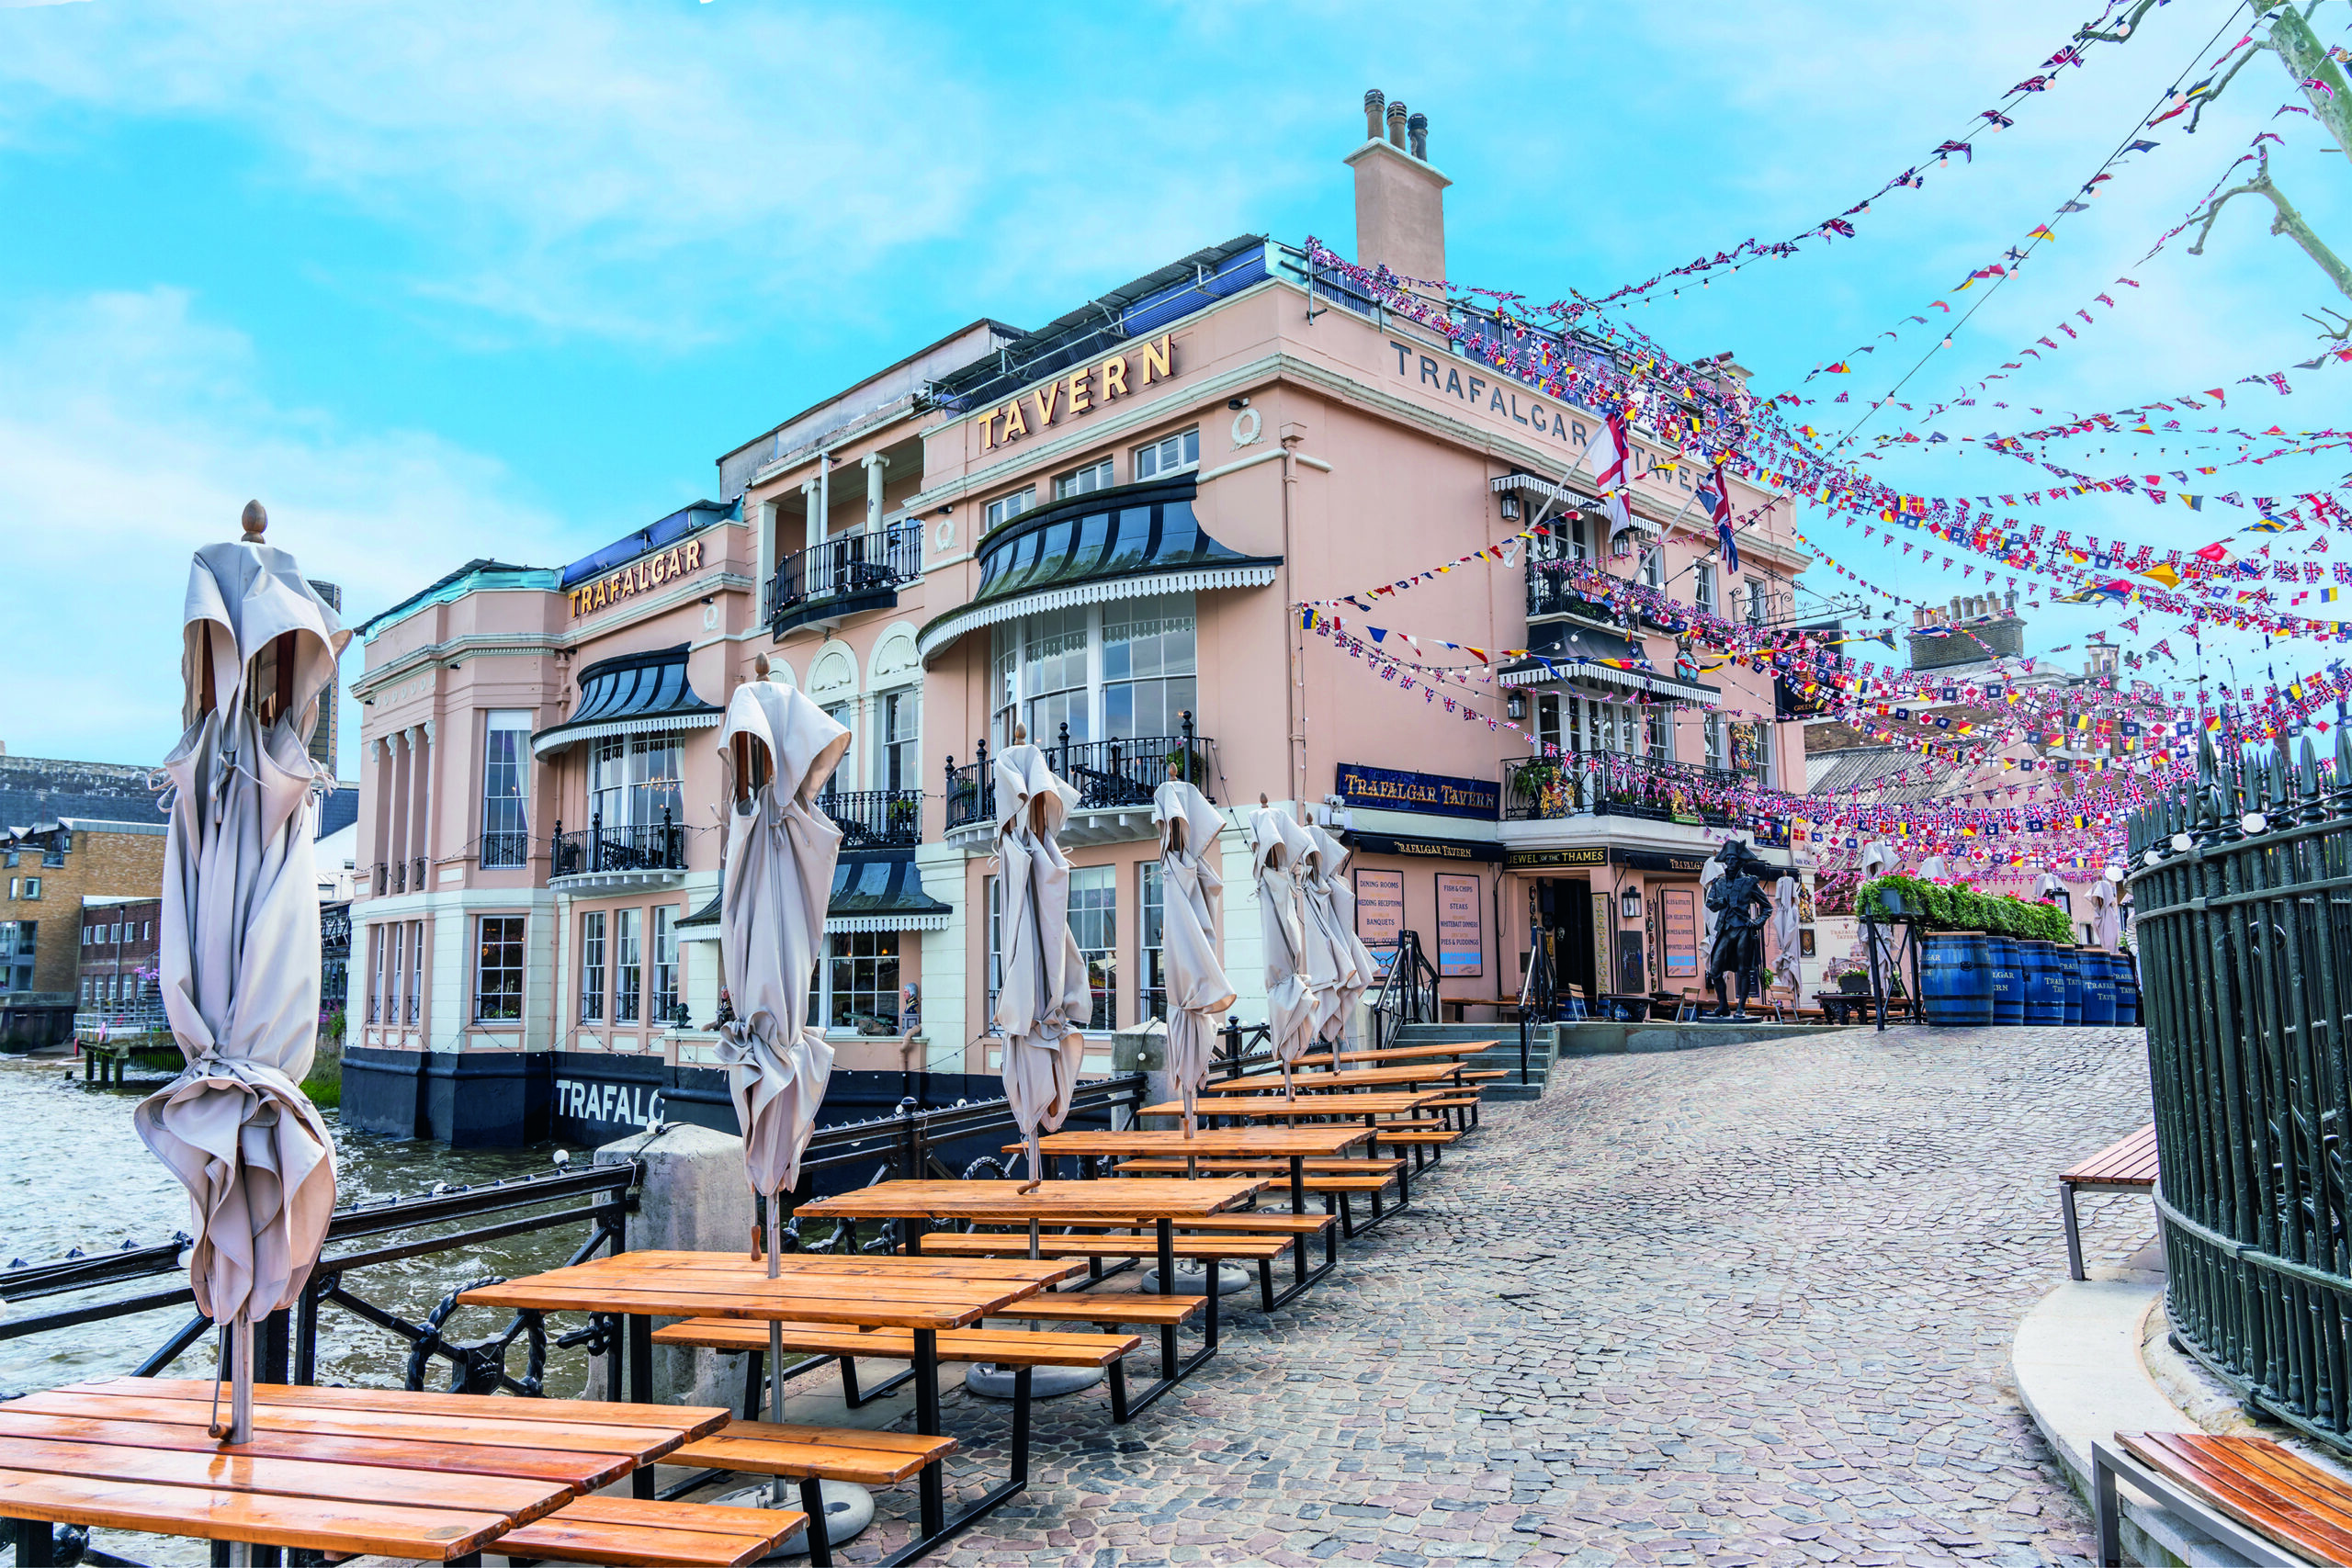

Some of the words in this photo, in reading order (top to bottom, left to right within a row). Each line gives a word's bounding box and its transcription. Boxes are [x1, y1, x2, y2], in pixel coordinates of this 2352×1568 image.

[978, 333, 1175, 450] TAVERN
[1389, 340, 1588, 448] TRAFALGAR
[568, 539, 702, 618] TRAFALGAR
[1345, 774, 1438, 803] TRAFALGAR
[1441, 785, 1496, 809] TAVERN
[1394, 840, 1442, 854] TRAFALGAR
[1442, 845, 1472, 857] TAVERN
[1508, 854, 1538, 863] JEWEL
[1562, 851, 1604, 862] THAMES
[1360, 880, 1378, 888] DINING
[1380, 881, 1399, 889] ROOMS
